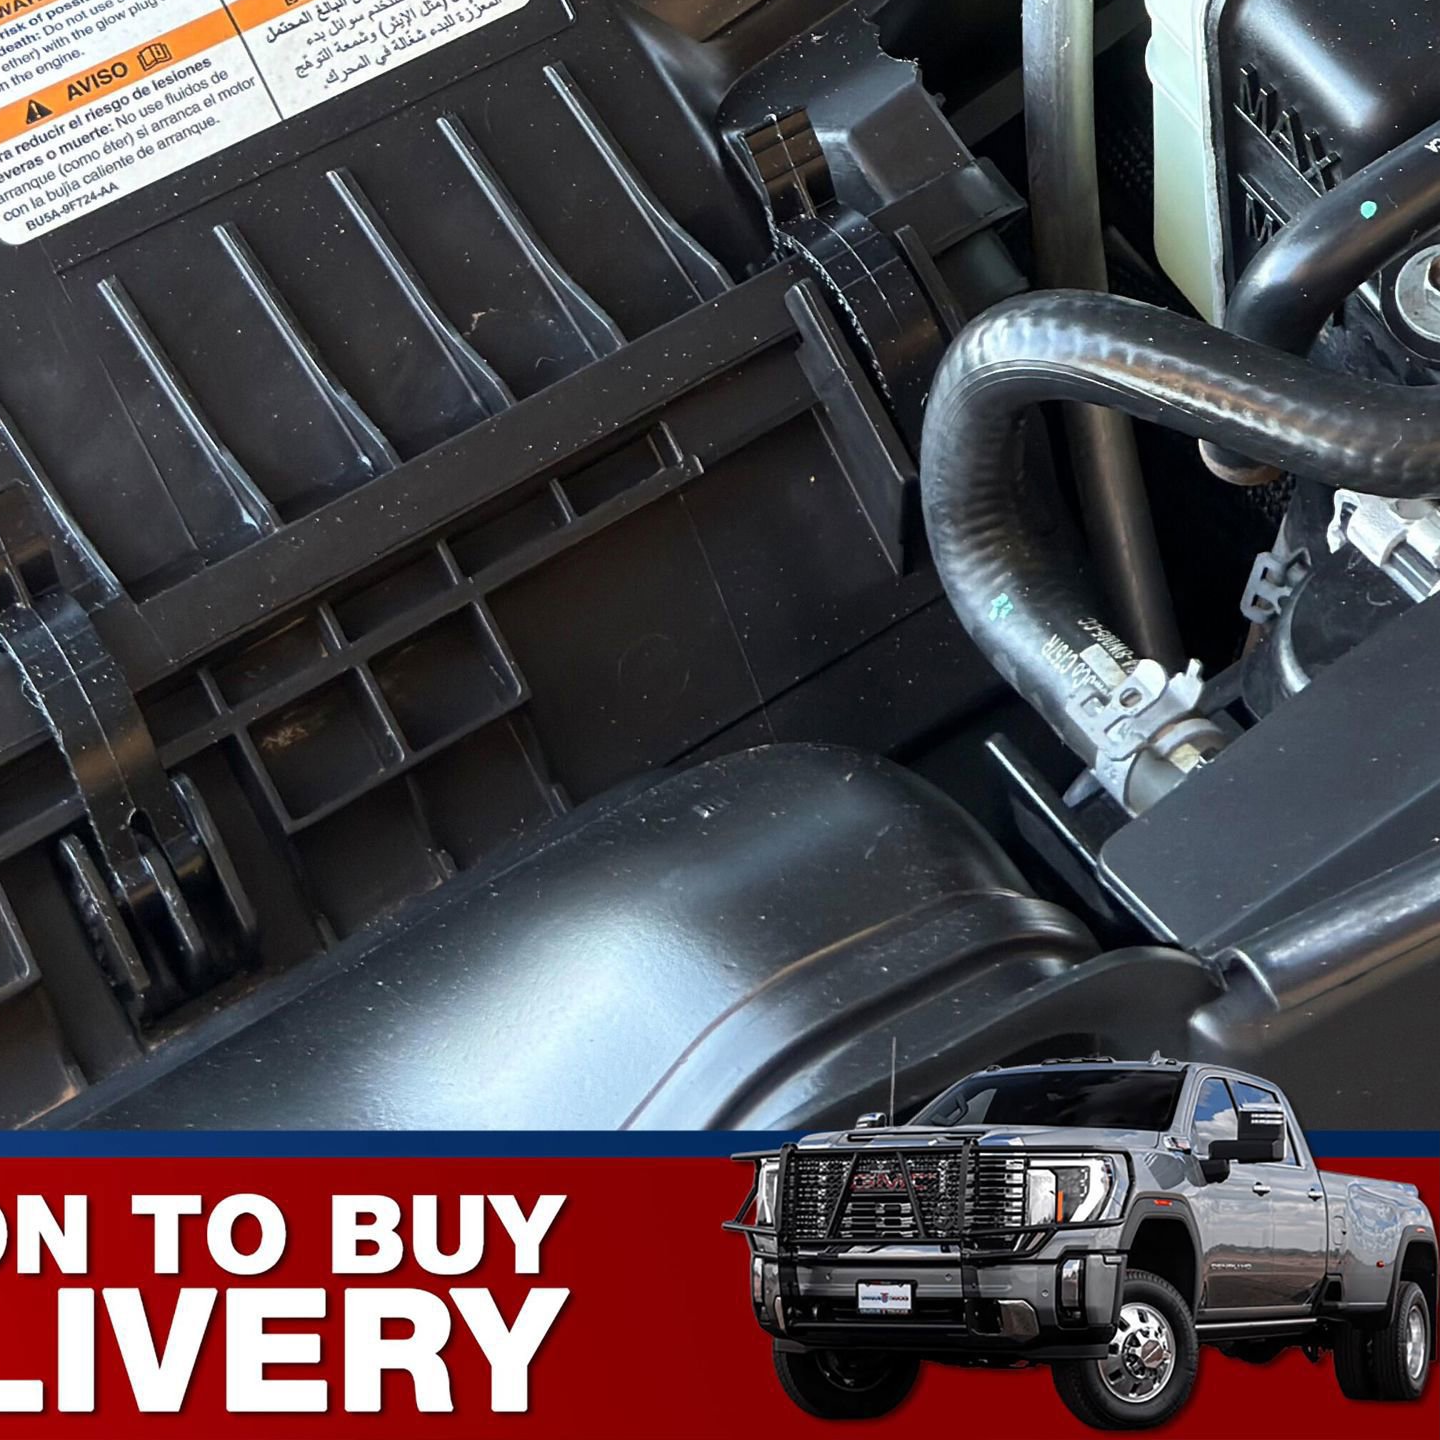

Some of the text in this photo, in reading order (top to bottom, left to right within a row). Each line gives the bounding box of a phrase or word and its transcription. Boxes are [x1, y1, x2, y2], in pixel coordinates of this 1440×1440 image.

[0, 46, 42, 74] ether)
[40, 35, 72, 55] with
[69, 24, 95, 42] the
[94, 9, 127, 33] glow
[27, 11, 45, 27] of
[40, 21, 65, 38] Do
[64, 9, 90, 28] not
[9, 69, 35, 87] the
[34, 48, 86, 76] engine.
[66, 60, 129, 103] AVISO
[13, 123, 67, 156] reducir
[67, 113, 85, 131] el
[83, 94, 131, 124] riesgo
[131, 85, 152, 102] de
[150, 57, 213, 92] lesiones
[44, 148, 58, 162] o
[57, 122, 116, 157] muerte:
[113, 111, 138, 130] No
[137, 99, 165, 119] use
[163, 78, 211, 107] fluidos
[209, 69, 230, 86] de
[1, 202, 31, 223] con
[28, 195, 48, 211] la
[81, 153, 136, 186] caliente
[135, 144, 156, 161] de
[155, 115, 222, 152] arranque.
[24, 180, 121, 233] BU5A-9F724-AA
